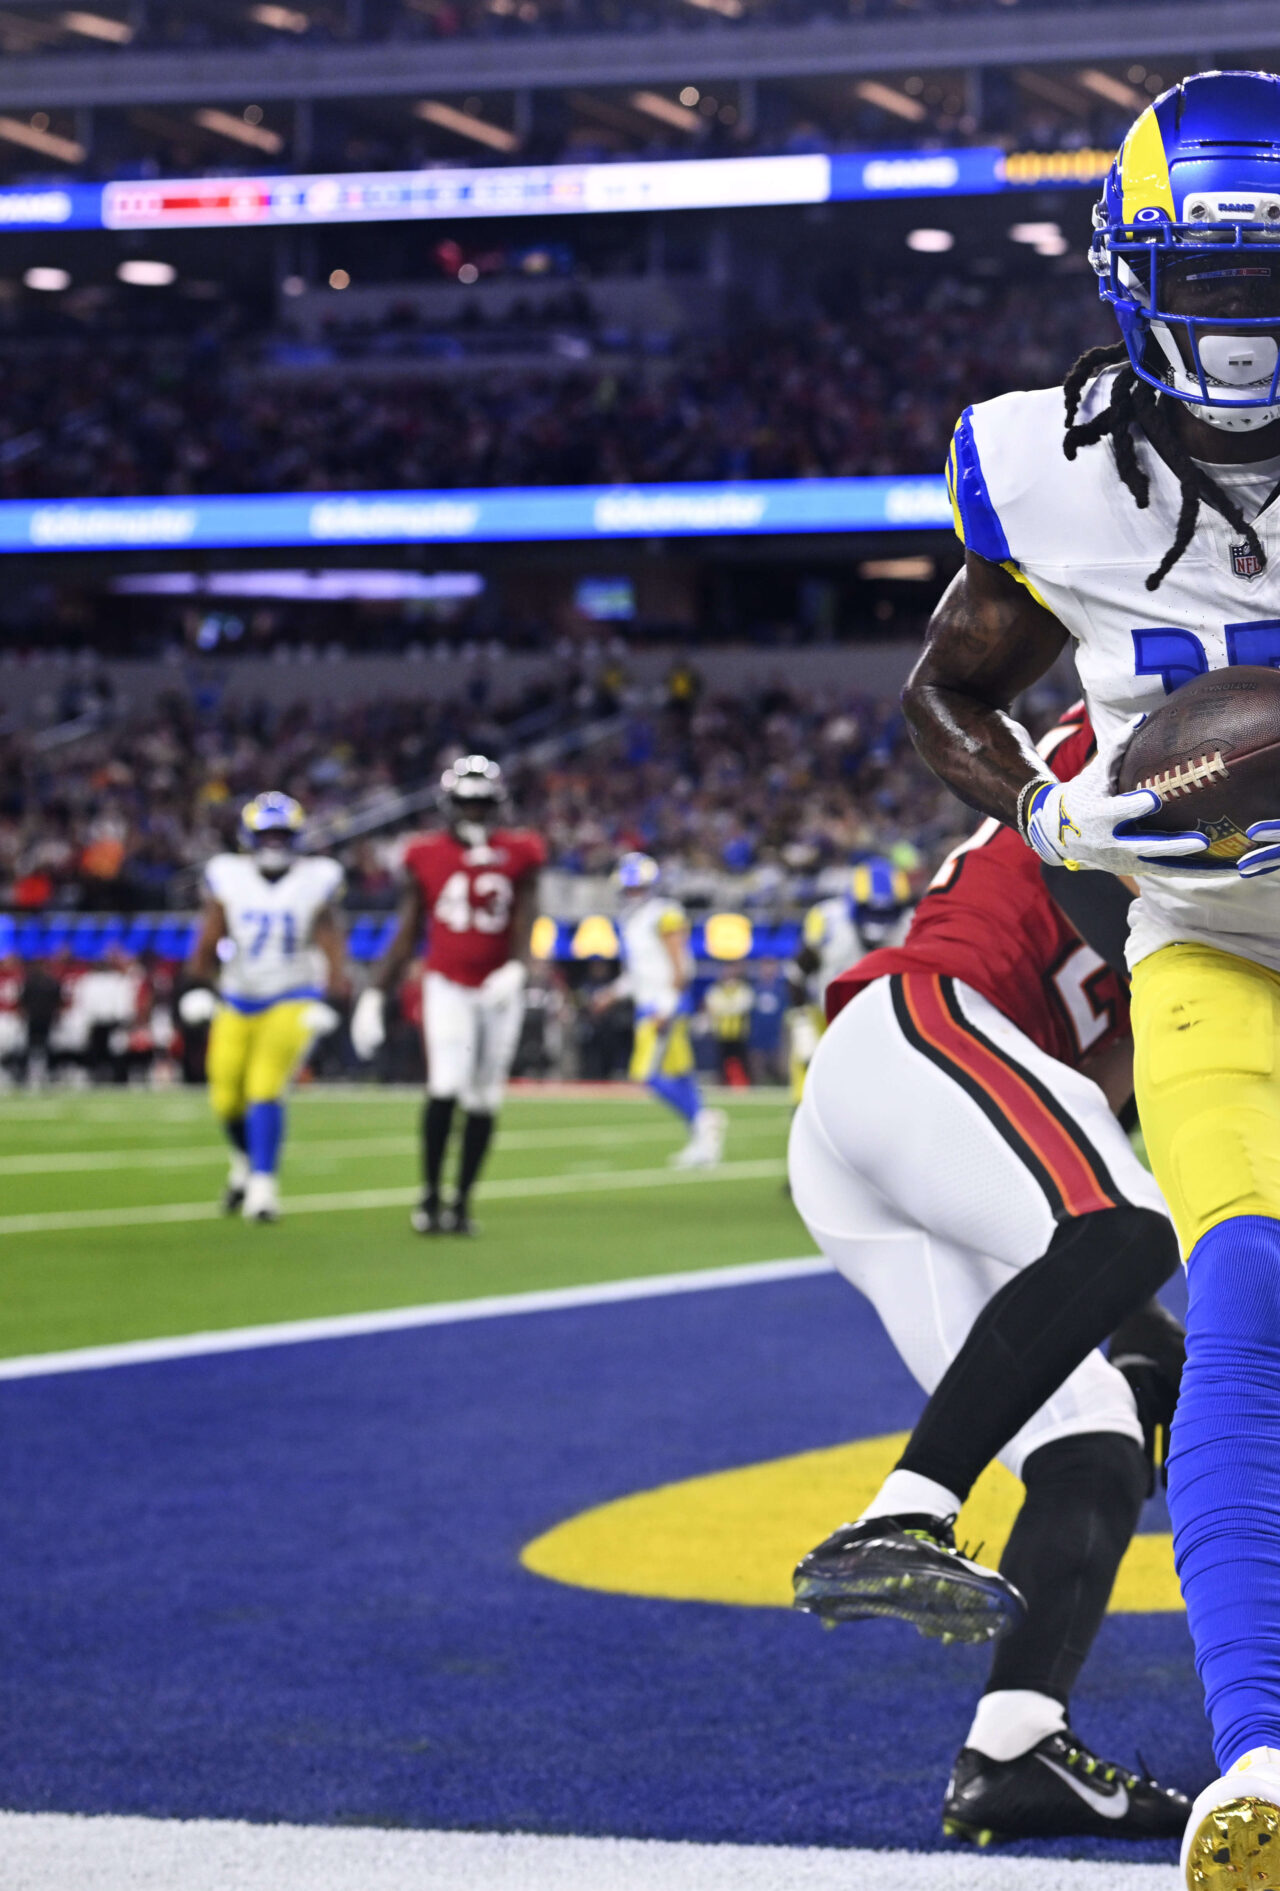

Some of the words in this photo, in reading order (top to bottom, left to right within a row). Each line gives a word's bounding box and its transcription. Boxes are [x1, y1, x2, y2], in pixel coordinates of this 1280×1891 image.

[1218, 203, 1255, 213] RAMS
[1235, 556, 1262, 574] NFL
[434, 871, 513, 934] 43
